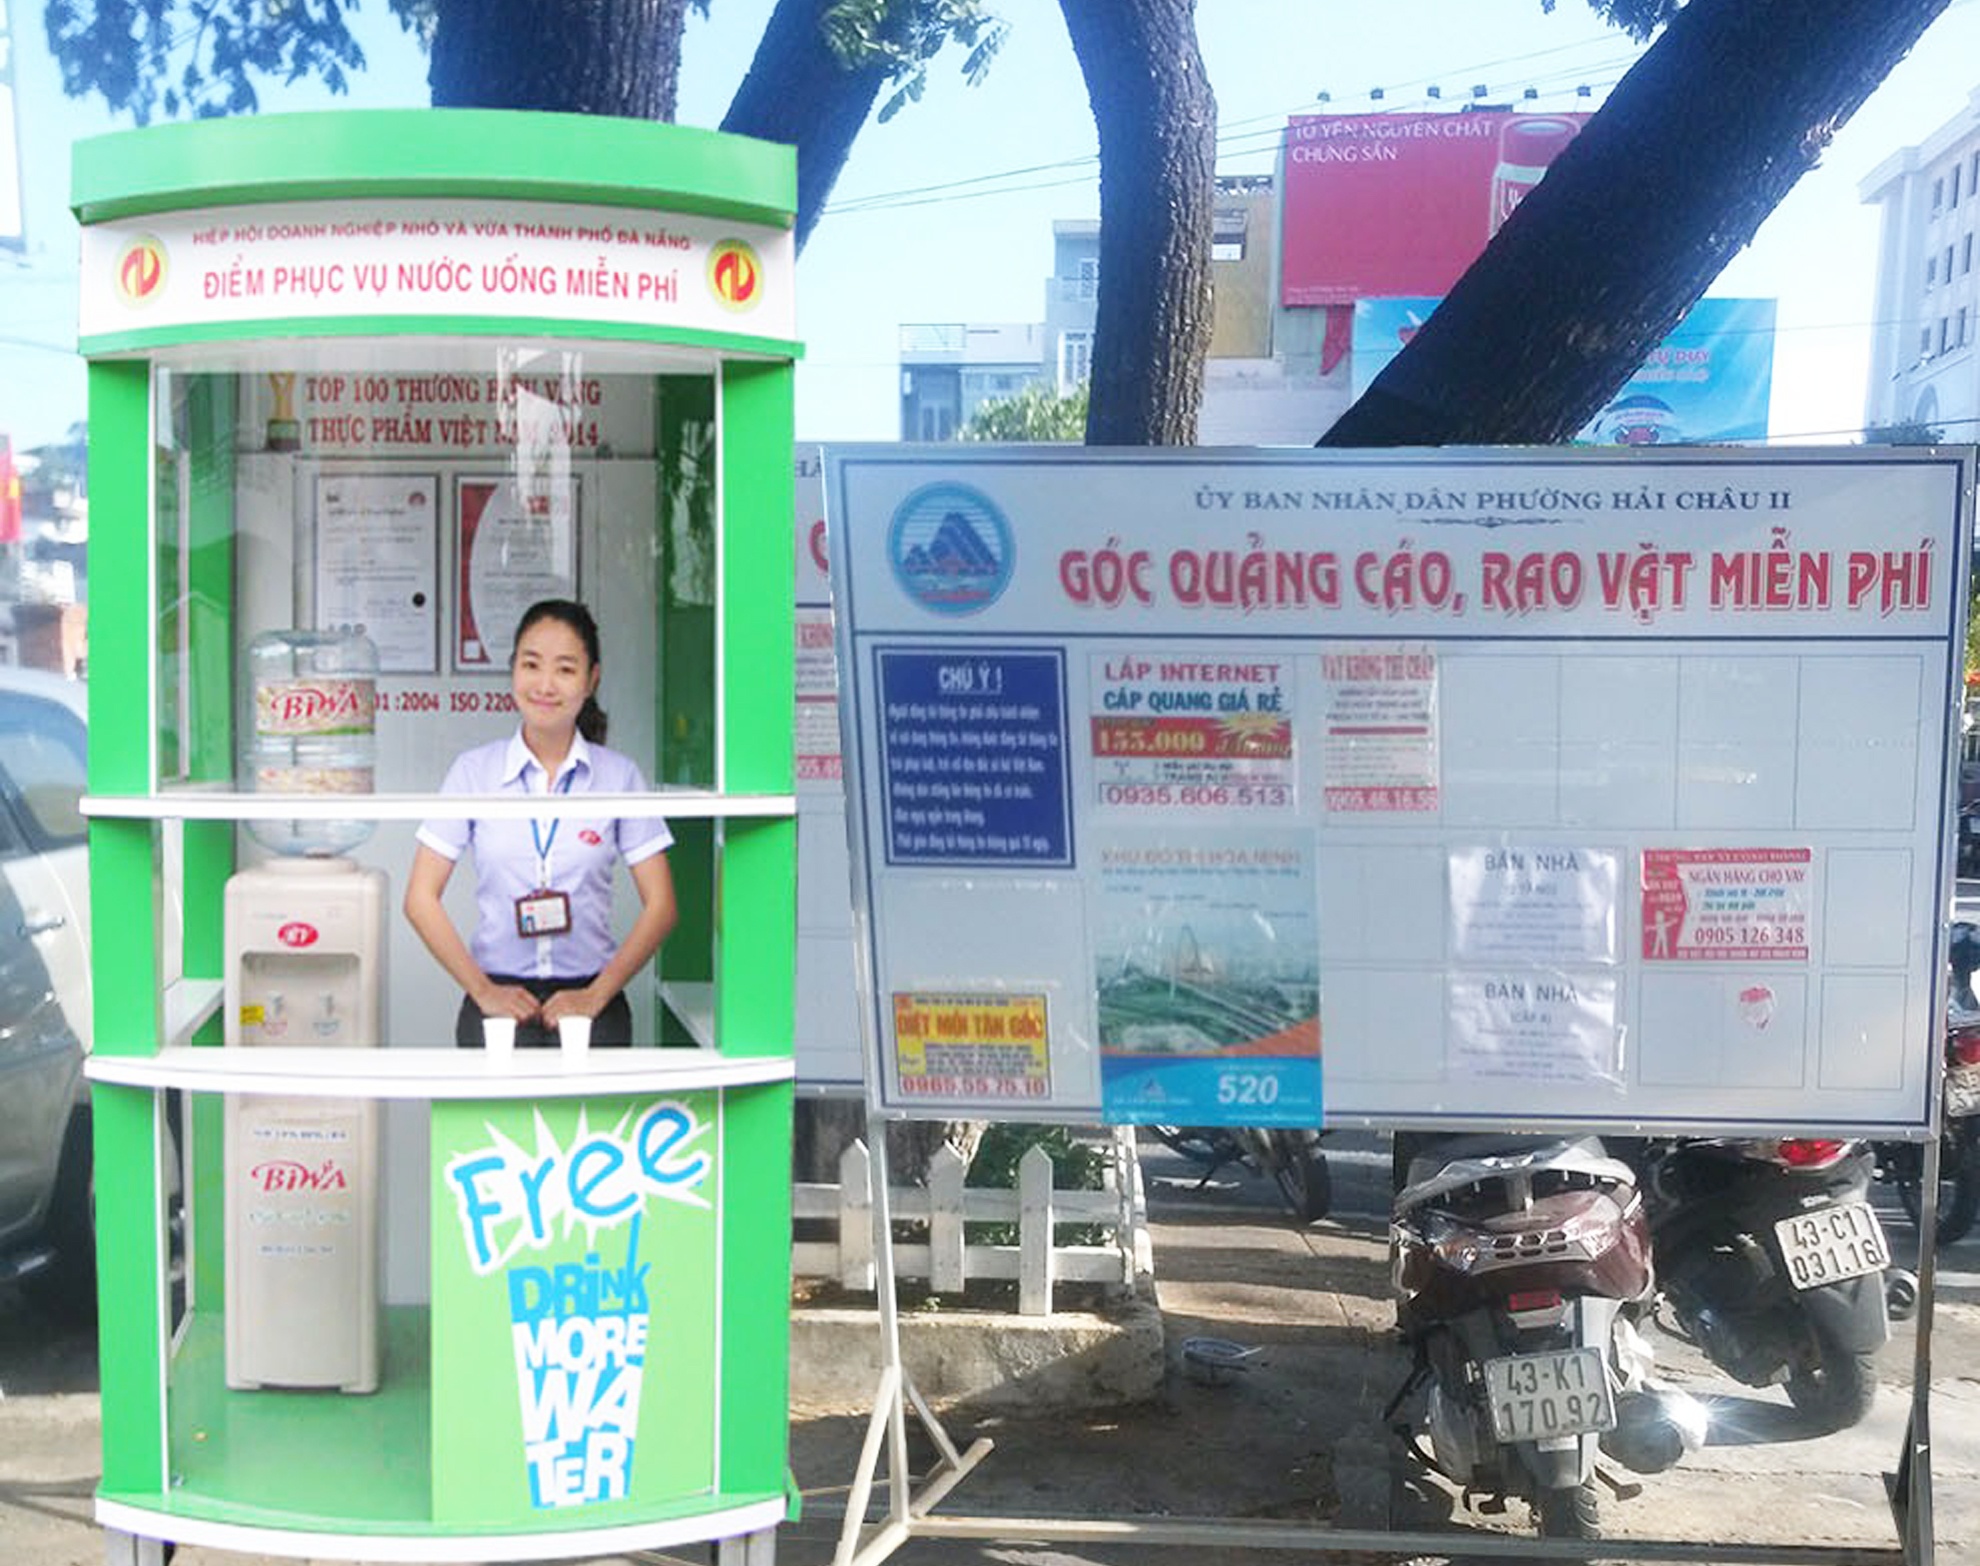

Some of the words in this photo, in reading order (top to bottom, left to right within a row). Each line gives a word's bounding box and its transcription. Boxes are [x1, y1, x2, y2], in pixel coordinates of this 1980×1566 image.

[267, 223, 326, 241] DOANH
[331, 220, 397, 238] NGHIỆP
[513, 221, 573, 240] THÀNH
[577, 224, 613, 243] PHỐ
[203, 253, 265, 299] ĐIỂM
[273, 264, 345, 299] PHỤC
[354, 263, 388, 298] VỤ
[398, 254, 472, 293] NƯỚC
[482, 252, 557, 295] UỐNG
[566, 255, 630, 299] MIỄN
[637, 268, 678, 304] PHÍ
[306, 377, 346, 403] TOP
[353, 377, 391, 403] 100
[439, 414, 487, 447] VIỆT
[1243, 491, 1303, 510] BAN
[1311, 490, 1396, 511] NHÂN
[1404, 491, 1467, 511] DÂN
[1476, 487, 1601, 511] PHƯỜNG
[1611, 487, 1666, 510] HẢI
[1675, 489, 1760, 510] CHÂU
[1769, 491, 1792, 510] II
[1058, 536, 1157, 608] GÓC
[1168, 532, 1343, 614] QUẢNG
[1481, 551, 1585, 617] RAO
[1597, 541, 1697, 623] VẬT
[1709, 526, 1832, 612] MIỄN
[1847, 538, 1936, 619] PHÍ
[938, 660, 974, 690] CHÚ
[1160, 663, 1281, 683] INTERNET
[450, 691, 480, 713] ISO
[1148, 690, 1212, 713] QUANG
[1217, 686, 1250, 713] GIÁ
[1257, 686, 1283, 713] RẺ
[1106, 785, 1286, 807] 0935.606.513
[1784, 869, 1806, 883] VAY
[1694, 927, 1735, 944] 0905
[1739, 926, 1770, 943] 126
[1775, 926, 1805, 944] 348
[1217, 1073, 1279, 1105] 520
[448, 1103, 707, 1270] Free
[1792, 1210, 1859, 1249] 43-C1
[1792, 1238, 1880, 1283] 031.16
[511, 1311, 649, 1373] MORE
[1507, 1354, 1586, 1396] 43-K1
[1502, 1392, 1603, 1436] 170.92
